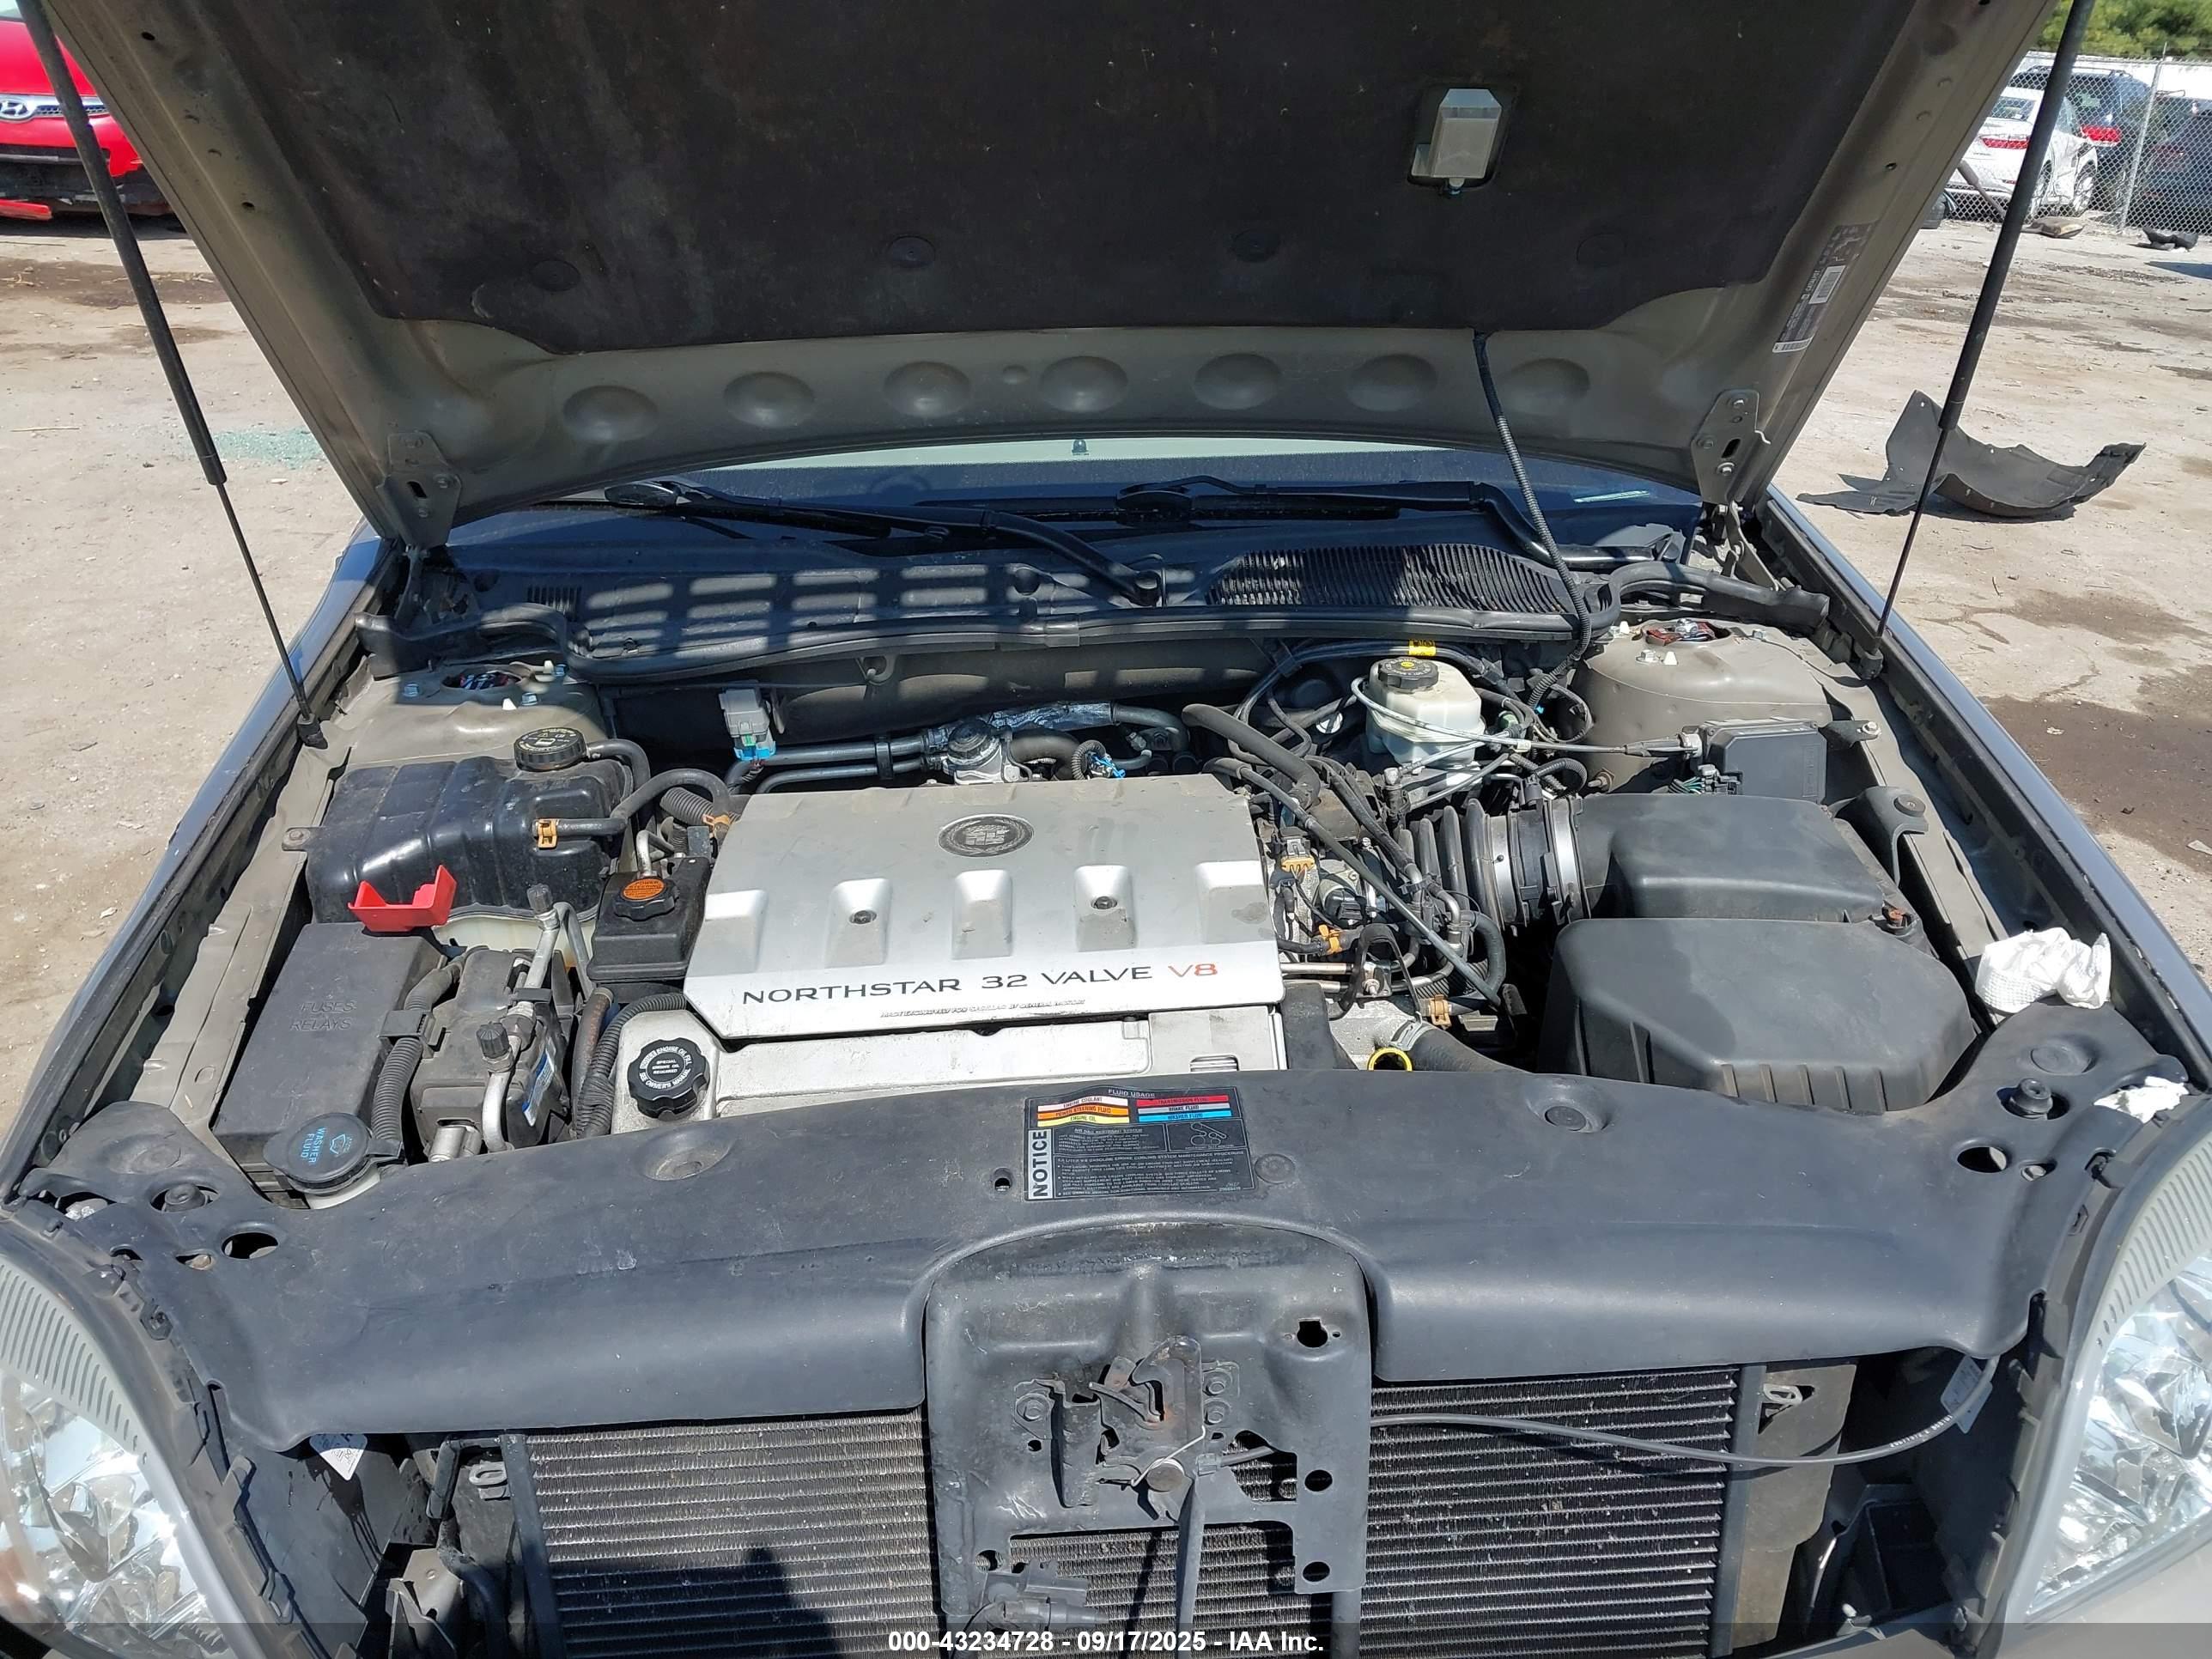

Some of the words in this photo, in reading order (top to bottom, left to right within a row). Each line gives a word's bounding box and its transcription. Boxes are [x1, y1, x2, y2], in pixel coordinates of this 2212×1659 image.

[743, 977, 962, 1005] NORTHSTAR
[982, 973, 1028, 991] 32
[1041, 964, 1153, 986] VALVE
[1167, 963, 1218, 978] V8
[301, 1000, 357, 1013] FUSES
[289, 1018, 352, 1032] RELAYS
[301, 1133, 315, 1159] FLUID
[308, 1127, 326, 1164] WASHER
[1032, 1130, 1048, 1197] NOTICE
